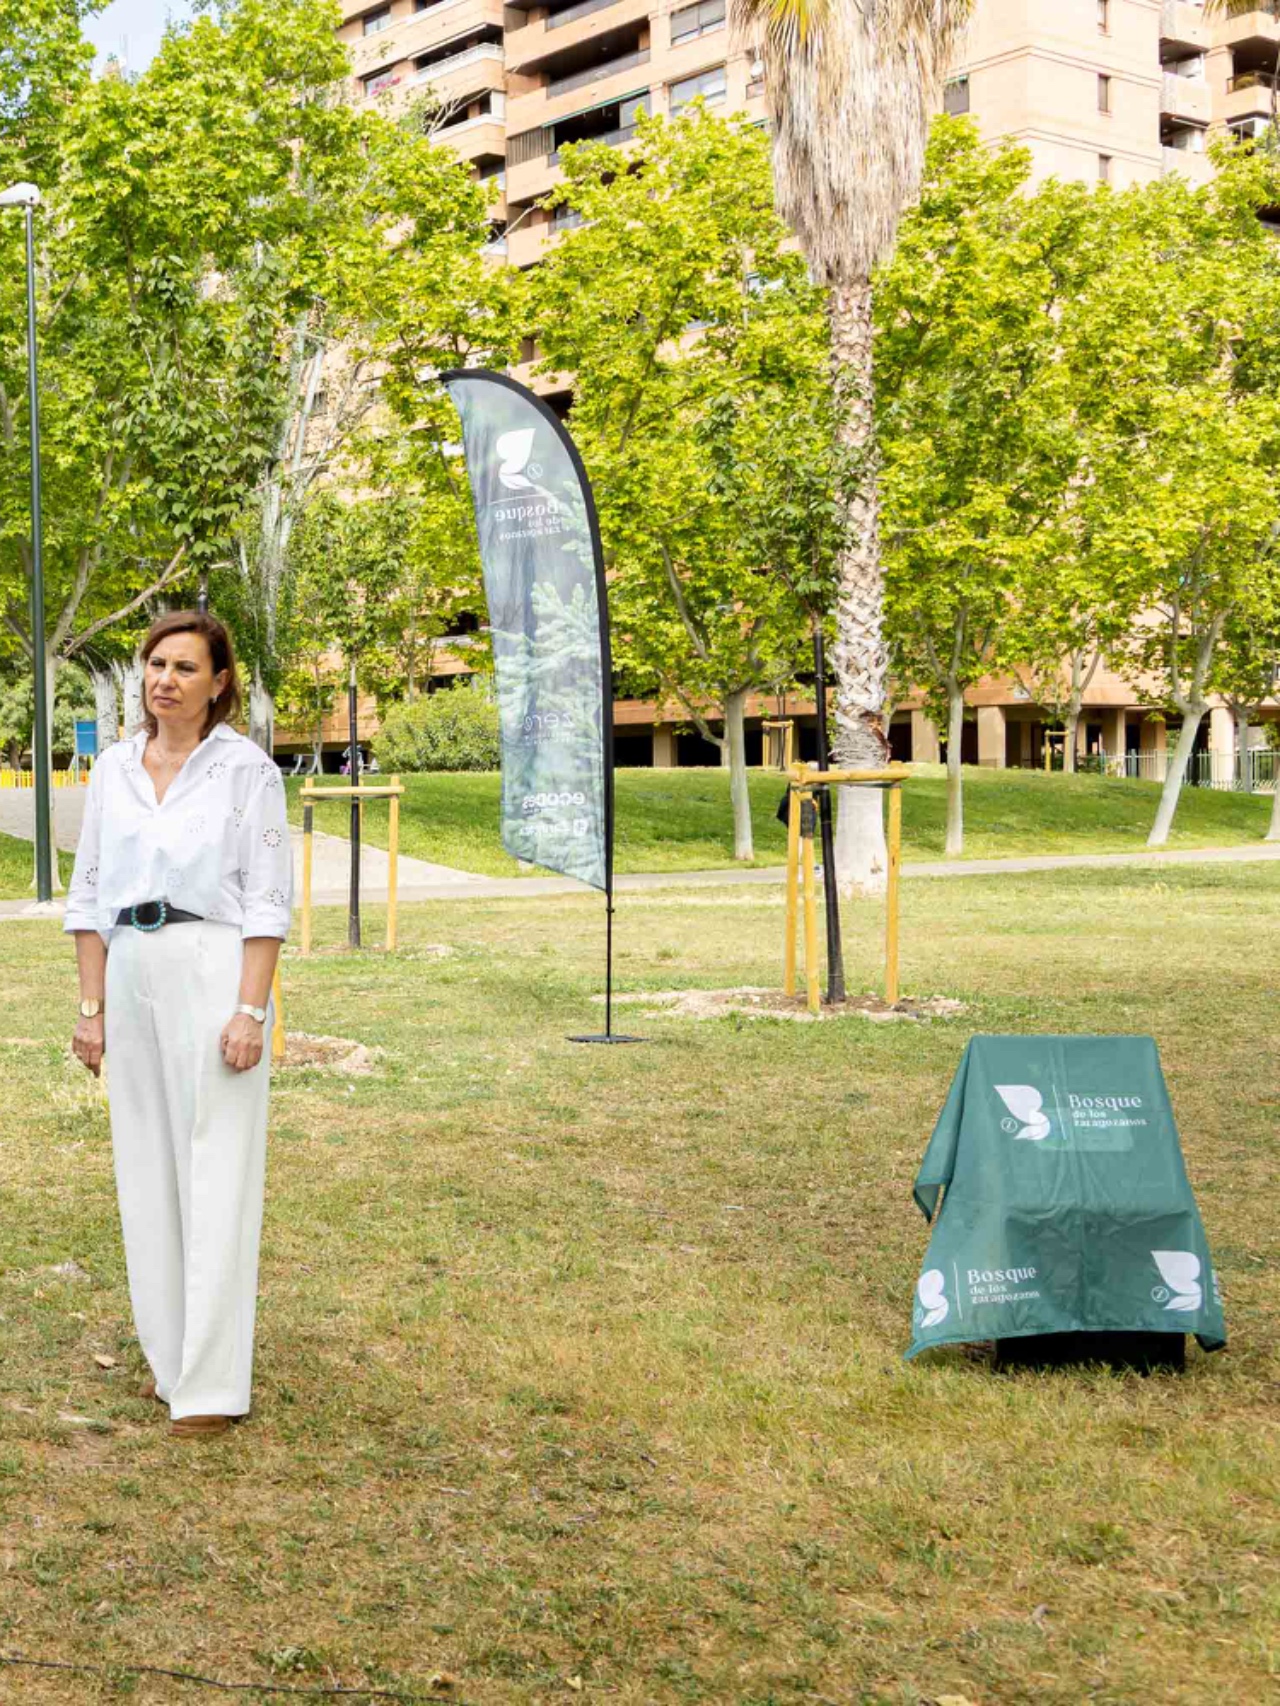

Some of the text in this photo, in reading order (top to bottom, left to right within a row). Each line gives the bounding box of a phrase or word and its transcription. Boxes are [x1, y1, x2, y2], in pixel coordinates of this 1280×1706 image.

[1068, 1094, 1143, 1111] Bosque
[1071, 1108, 1107, 1119] de los
[967, 1266, 1037, 1285] Bosque
[969, 1284, 1008, 1296] de los
